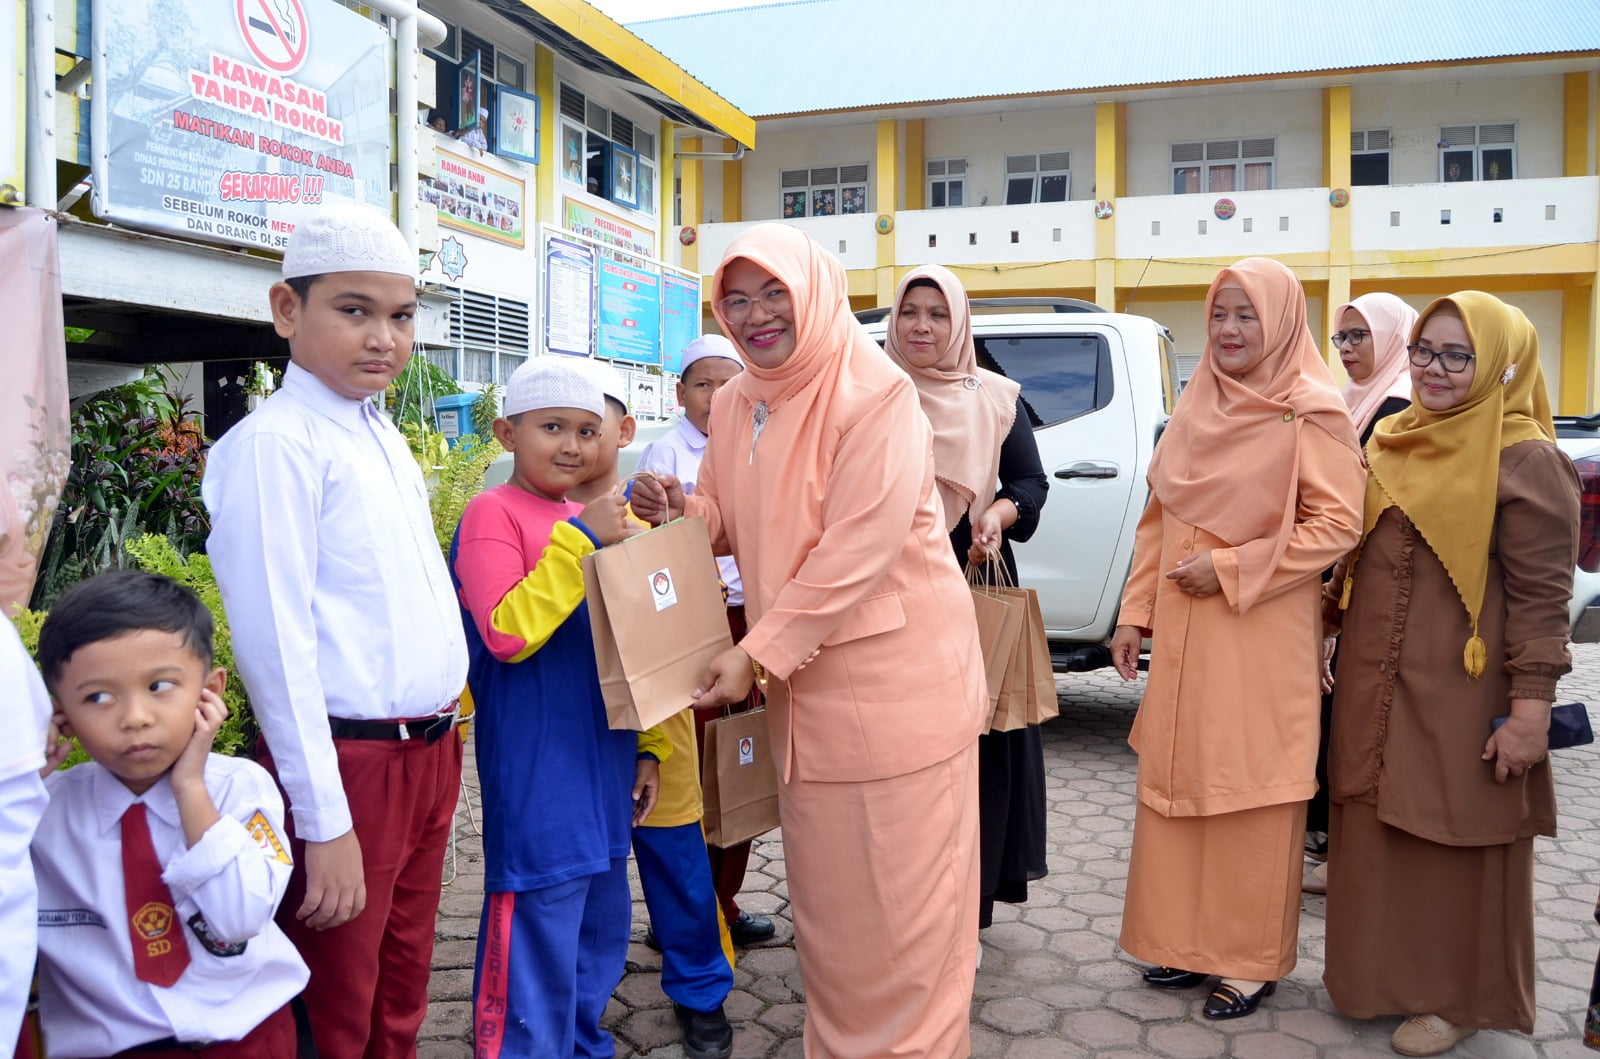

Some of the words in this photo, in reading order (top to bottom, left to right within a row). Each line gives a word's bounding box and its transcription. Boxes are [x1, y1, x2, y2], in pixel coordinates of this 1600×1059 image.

[213, 56, 324, 113] KAWASAN
[192, 74, 267, 117] TANPA
[274, 102, 341, 142] ROKOK
[146, 141, 188, 160] PEMERINTAH
[174, 110, 254, 150] MATIKAN
[259, 136, 313, 166] ROKOK
[316, 155, 353, 178] ANDA
[134, 152, 157, 166] DINAS
[158, 158, 199, 175] PENDIDIKAN
[442, 160, 467, 178] RAMAH
[467, 170, 486, 185] ANAK
[140, 168, 164, 187] SDN
[167, 174, 180, 190] 25
[183, 177, 218, 196] BANDA
[220, 171, 300, 204] SEKARANG
[302, 175, 324, 204] !!!
[164, 197, 224, 219] SEBELUM
[228, 210, 268, 229] ROKOK
[187, 218, 213, 232] DAN
[217, 224, 257, 242] ORANG
[147, 939, 171, 957] SD
[483, 994, 504, 1015] 25
